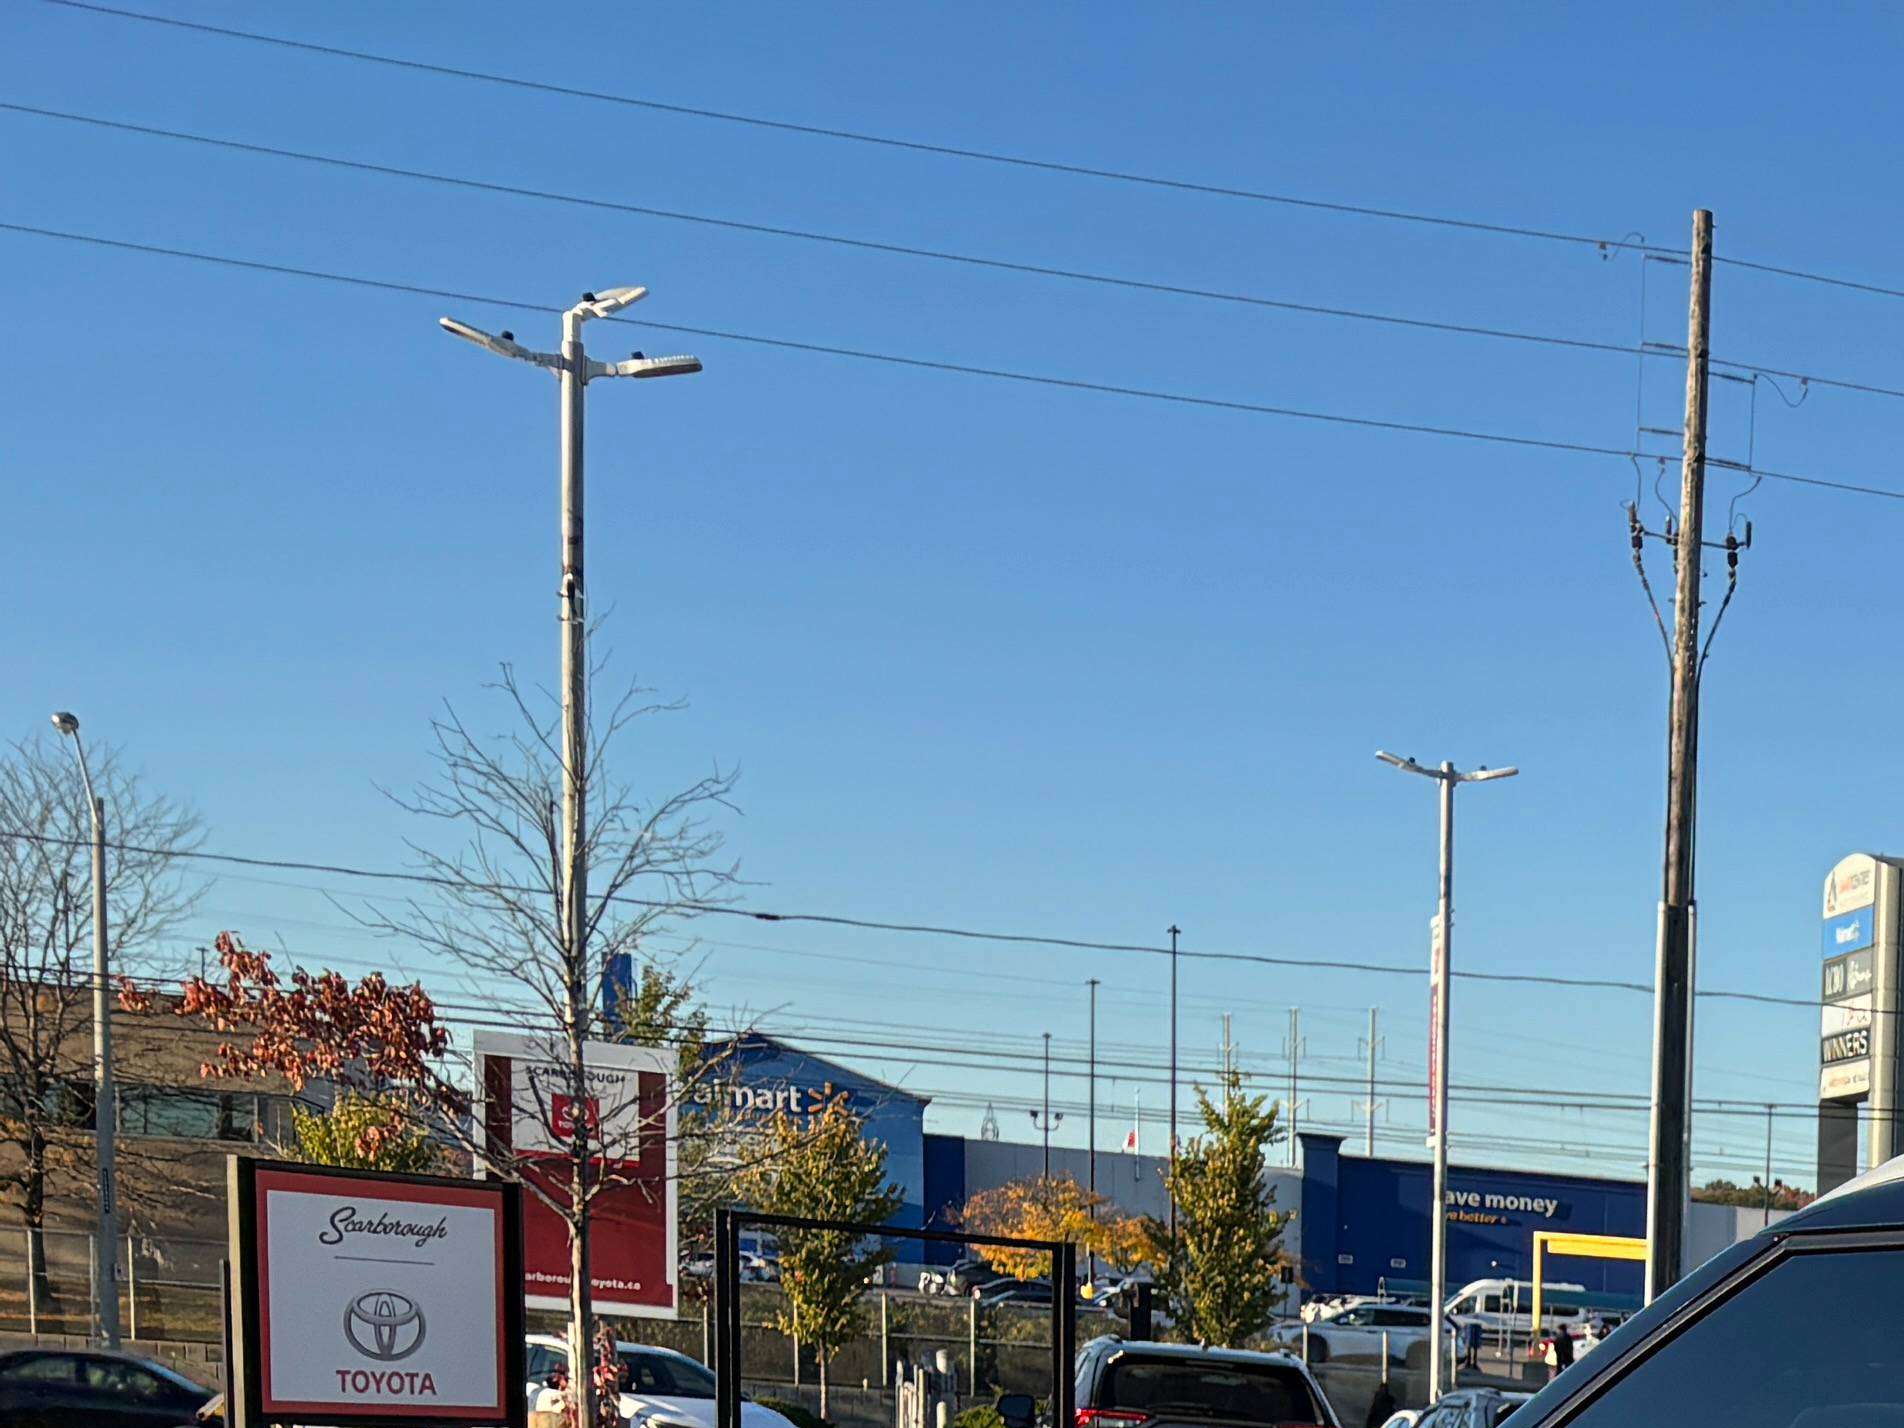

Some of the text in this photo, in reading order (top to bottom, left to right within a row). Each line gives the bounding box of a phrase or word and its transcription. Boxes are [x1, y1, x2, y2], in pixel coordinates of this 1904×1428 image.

[692, 1077, 802, 1113] almart
[1445, 1190, 1558, 1218] ave money
[319, 1206, 448, 1247] Scarborough
[336, 1370, 437, 1395] TOYOTA
